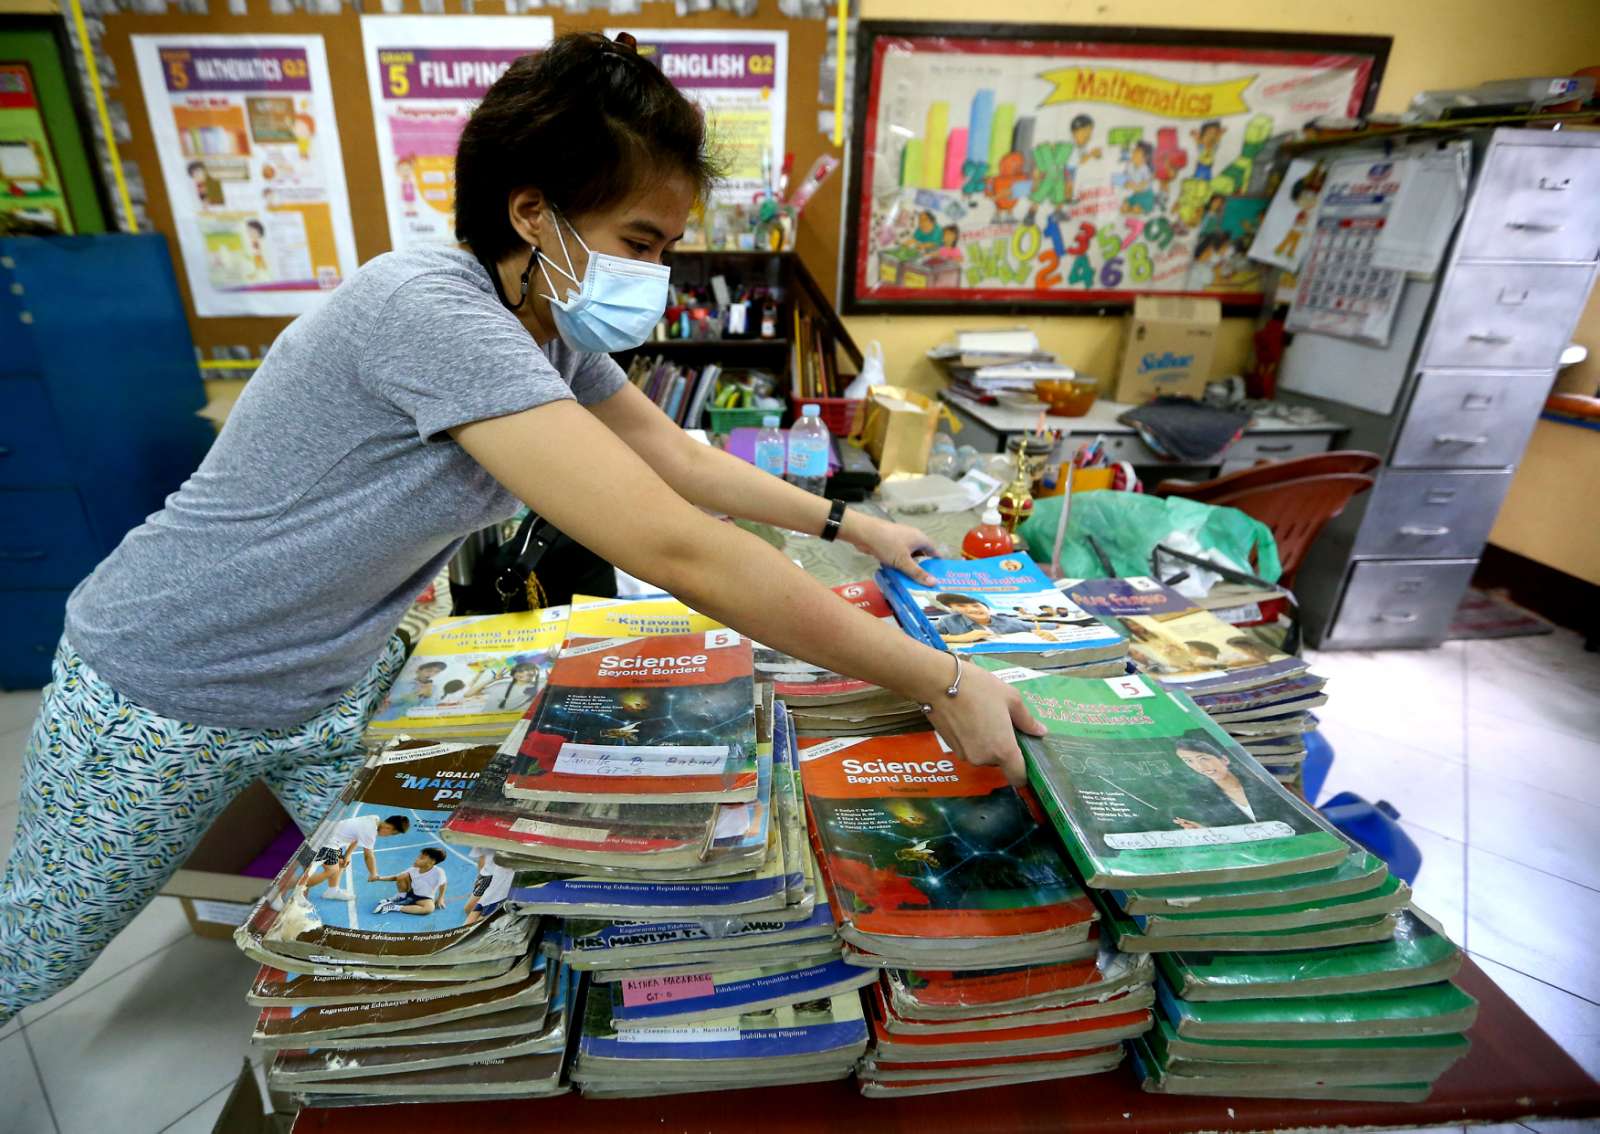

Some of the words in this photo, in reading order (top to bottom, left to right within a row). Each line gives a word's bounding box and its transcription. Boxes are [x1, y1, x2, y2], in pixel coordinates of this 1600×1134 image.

[661, 53, 745, 78] ENGLISH
[748, 55, 773, 74] Q2
[388, 64, 411, 97] 5
[1073, 71, 1213, 115] Mathematics
[618, 616, 691, 626] Katawan
[639, 626, 691, 635] Isipan
[714, 633, 729, 646] 5
[599, 653, 709, 670] Science
[597, 667, 648, 678] Beyond
[652, 666, 706, 676] Borders
[1120, 682, 1140, 696] 5
[841, 758, 955, 775] Science
[436, 770, 481, 779] UGALIN
[847, 774, 899, 785] Beyond
[903, 773, 960, 783] Borders
[564, 882, 602, 892] Kagawaran
[613, 883, 650, 892] Edukasyon
[656, 883, 691, 892] Republika
[700, 883, 730, 892] Pilipinas
[371, 931, 406, 942] Edukasyon
[756, 973, 790, 987] Republika
[319, 1003, 360, 1016] Kagawaran
[360, 1002, 370, 1011] ng
[740, 1031, 767, 1041] publika
[778, 1029, 808, 1040] Pilipinas
